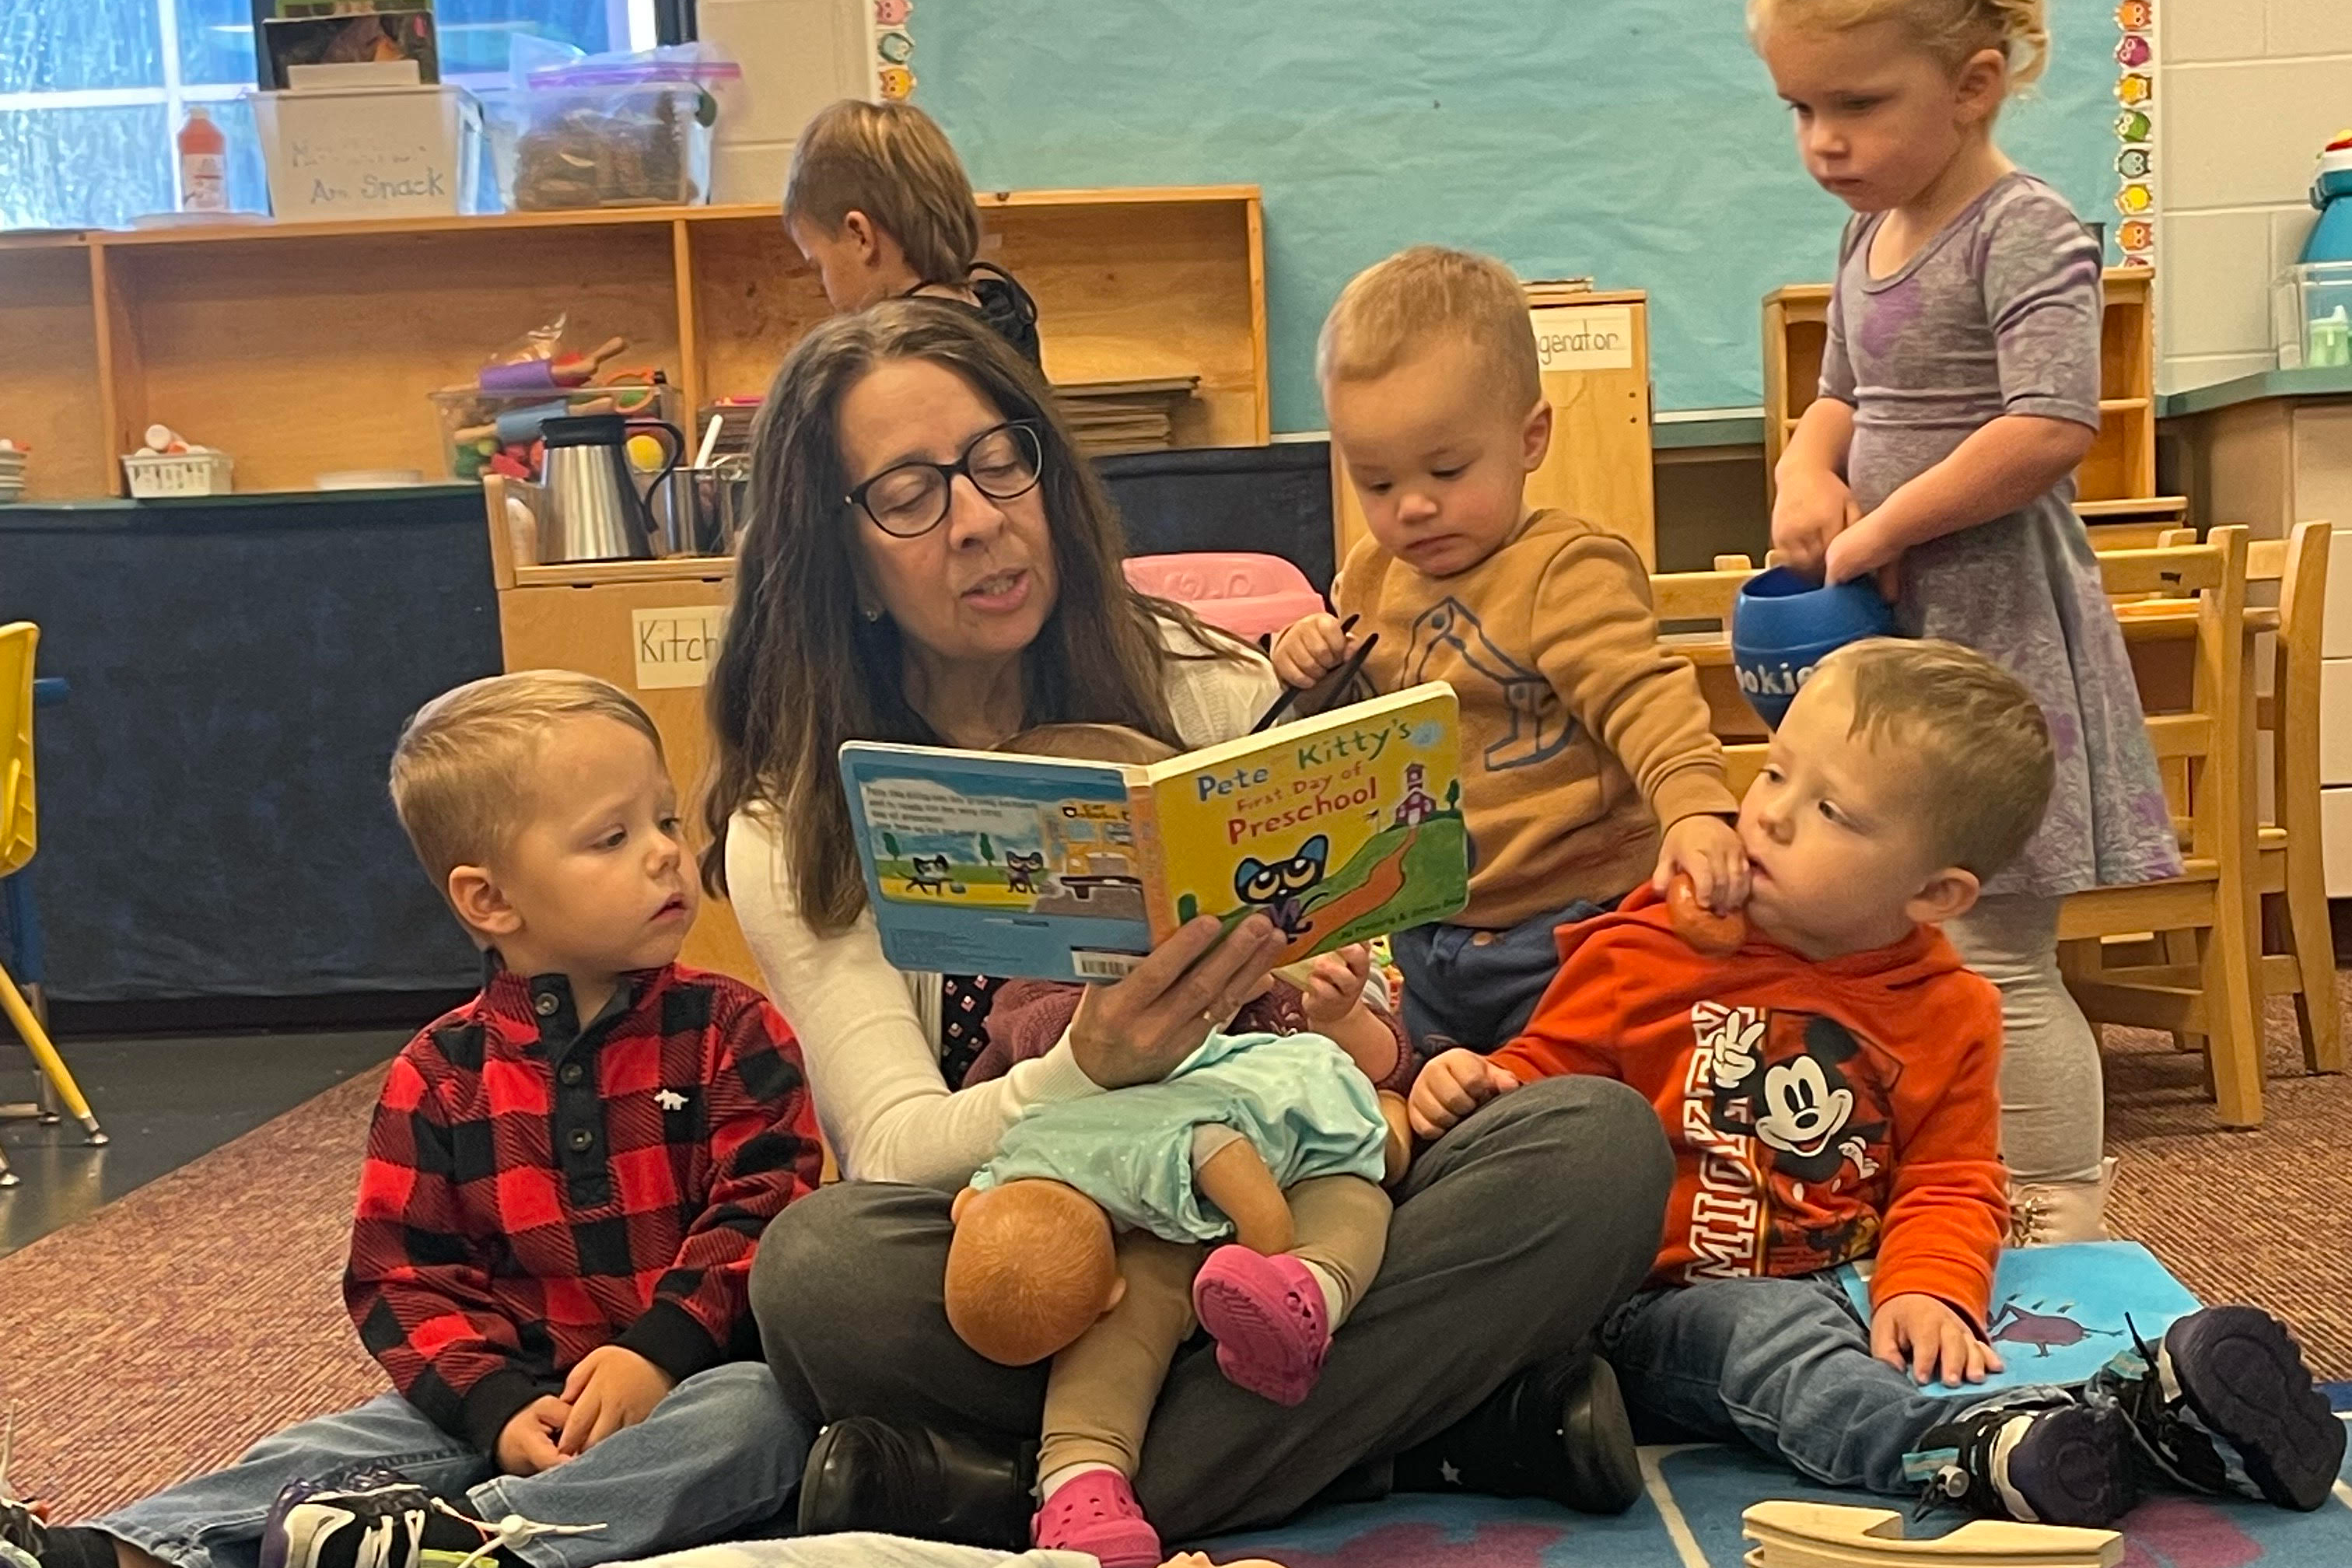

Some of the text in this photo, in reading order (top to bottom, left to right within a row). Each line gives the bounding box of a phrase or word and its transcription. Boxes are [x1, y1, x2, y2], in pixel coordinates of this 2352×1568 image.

[361, 166, 445, 199] Snack
[1540, 318, 1619, 365] gerator
[640, 618, 718, 663] Kitch
[1197, 719, 1411, 802] Pete Kitty's
[1228, 776, 1377, 845] Preschool
[1236, 760, 1363, 814] First Day of
